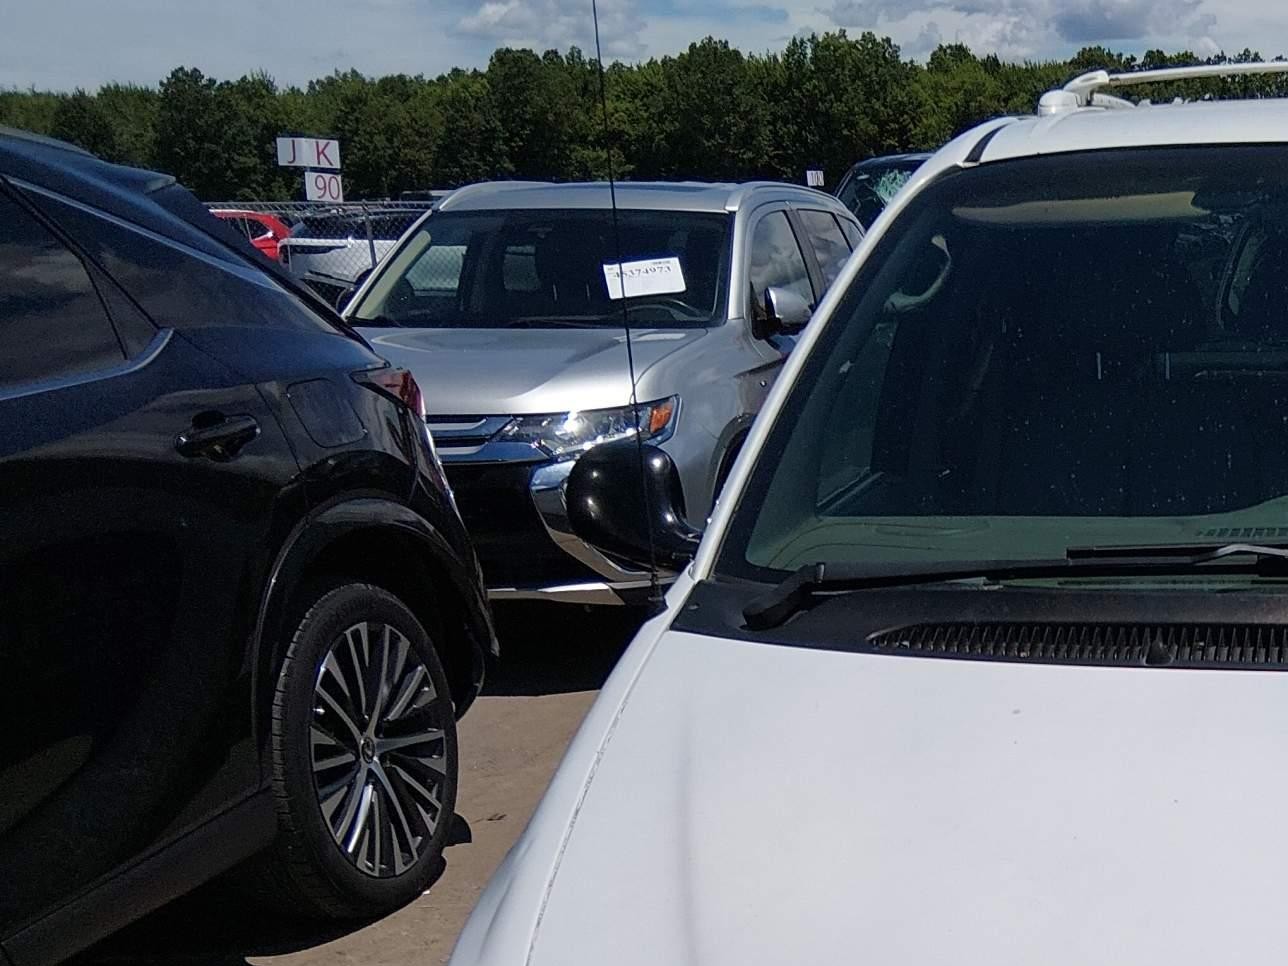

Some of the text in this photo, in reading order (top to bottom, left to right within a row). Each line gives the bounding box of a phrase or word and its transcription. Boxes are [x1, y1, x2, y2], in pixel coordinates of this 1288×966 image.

[287, 139, 334, 166] J K
[314, 174, 340, 200] 90
